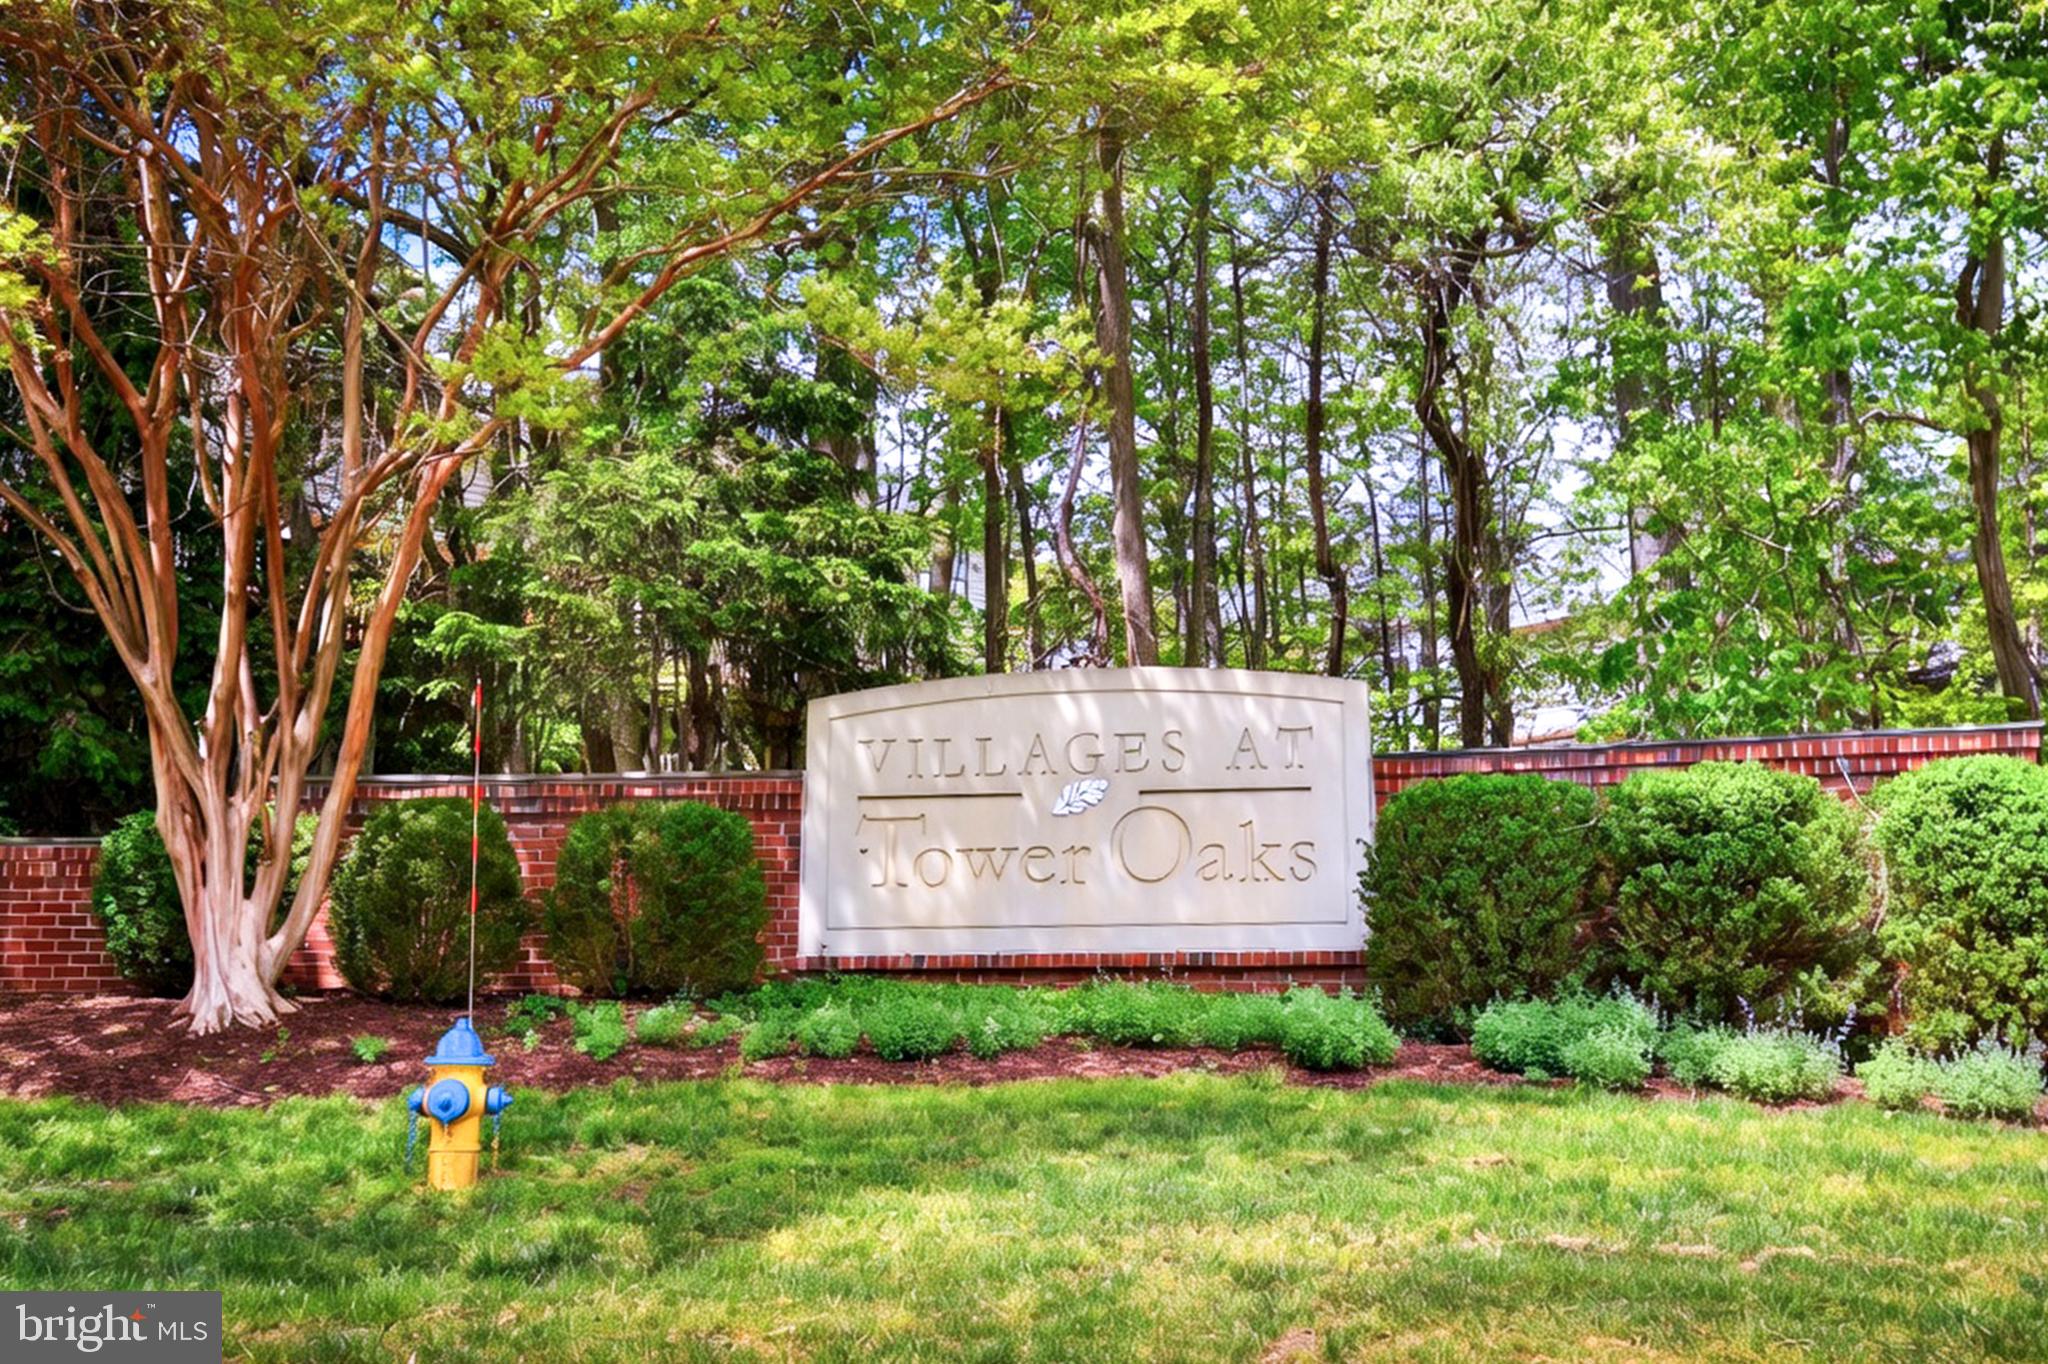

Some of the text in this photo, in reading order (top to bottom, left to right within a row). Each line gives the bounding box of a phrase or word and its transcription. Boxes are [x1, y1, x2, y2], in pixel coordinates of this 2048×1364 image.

[857, 725, 1314, 780] VILLAGES AT
[855, 805, 1318, 888] Tower Oaks
